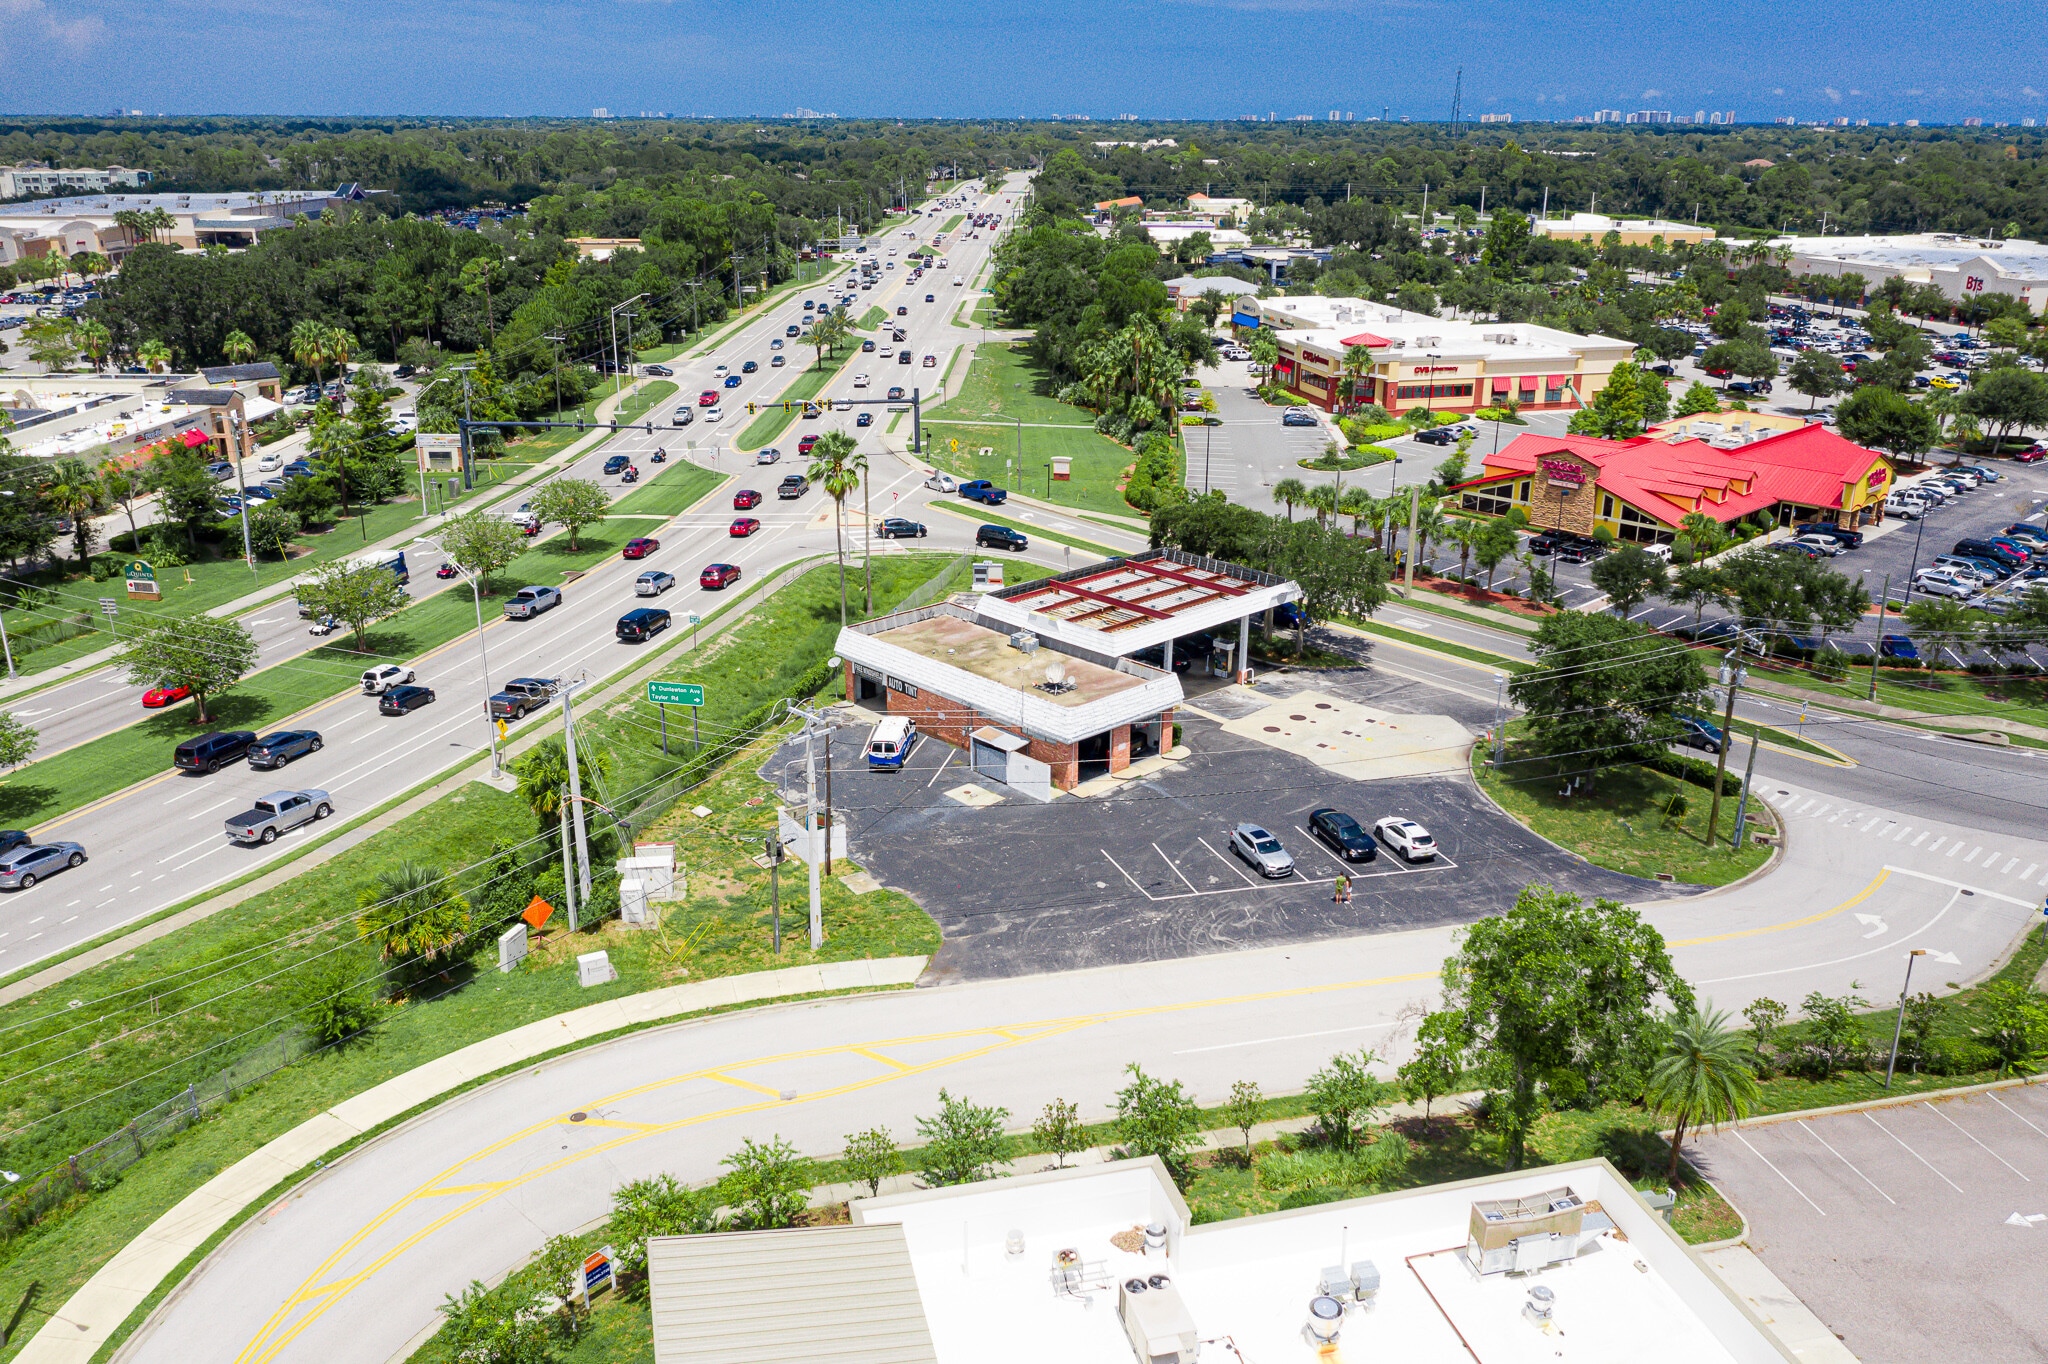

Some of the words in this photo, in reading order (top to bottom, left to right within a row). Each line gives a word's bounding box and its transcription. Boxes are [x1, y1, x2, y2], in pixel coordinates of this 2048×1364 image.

[658, 685, 687, 693] Dunlawton
[888, 676, 903, 692] AUTO
[904, 683, 918, 697] TINT
[651, 693, 668, 701] Taylor
